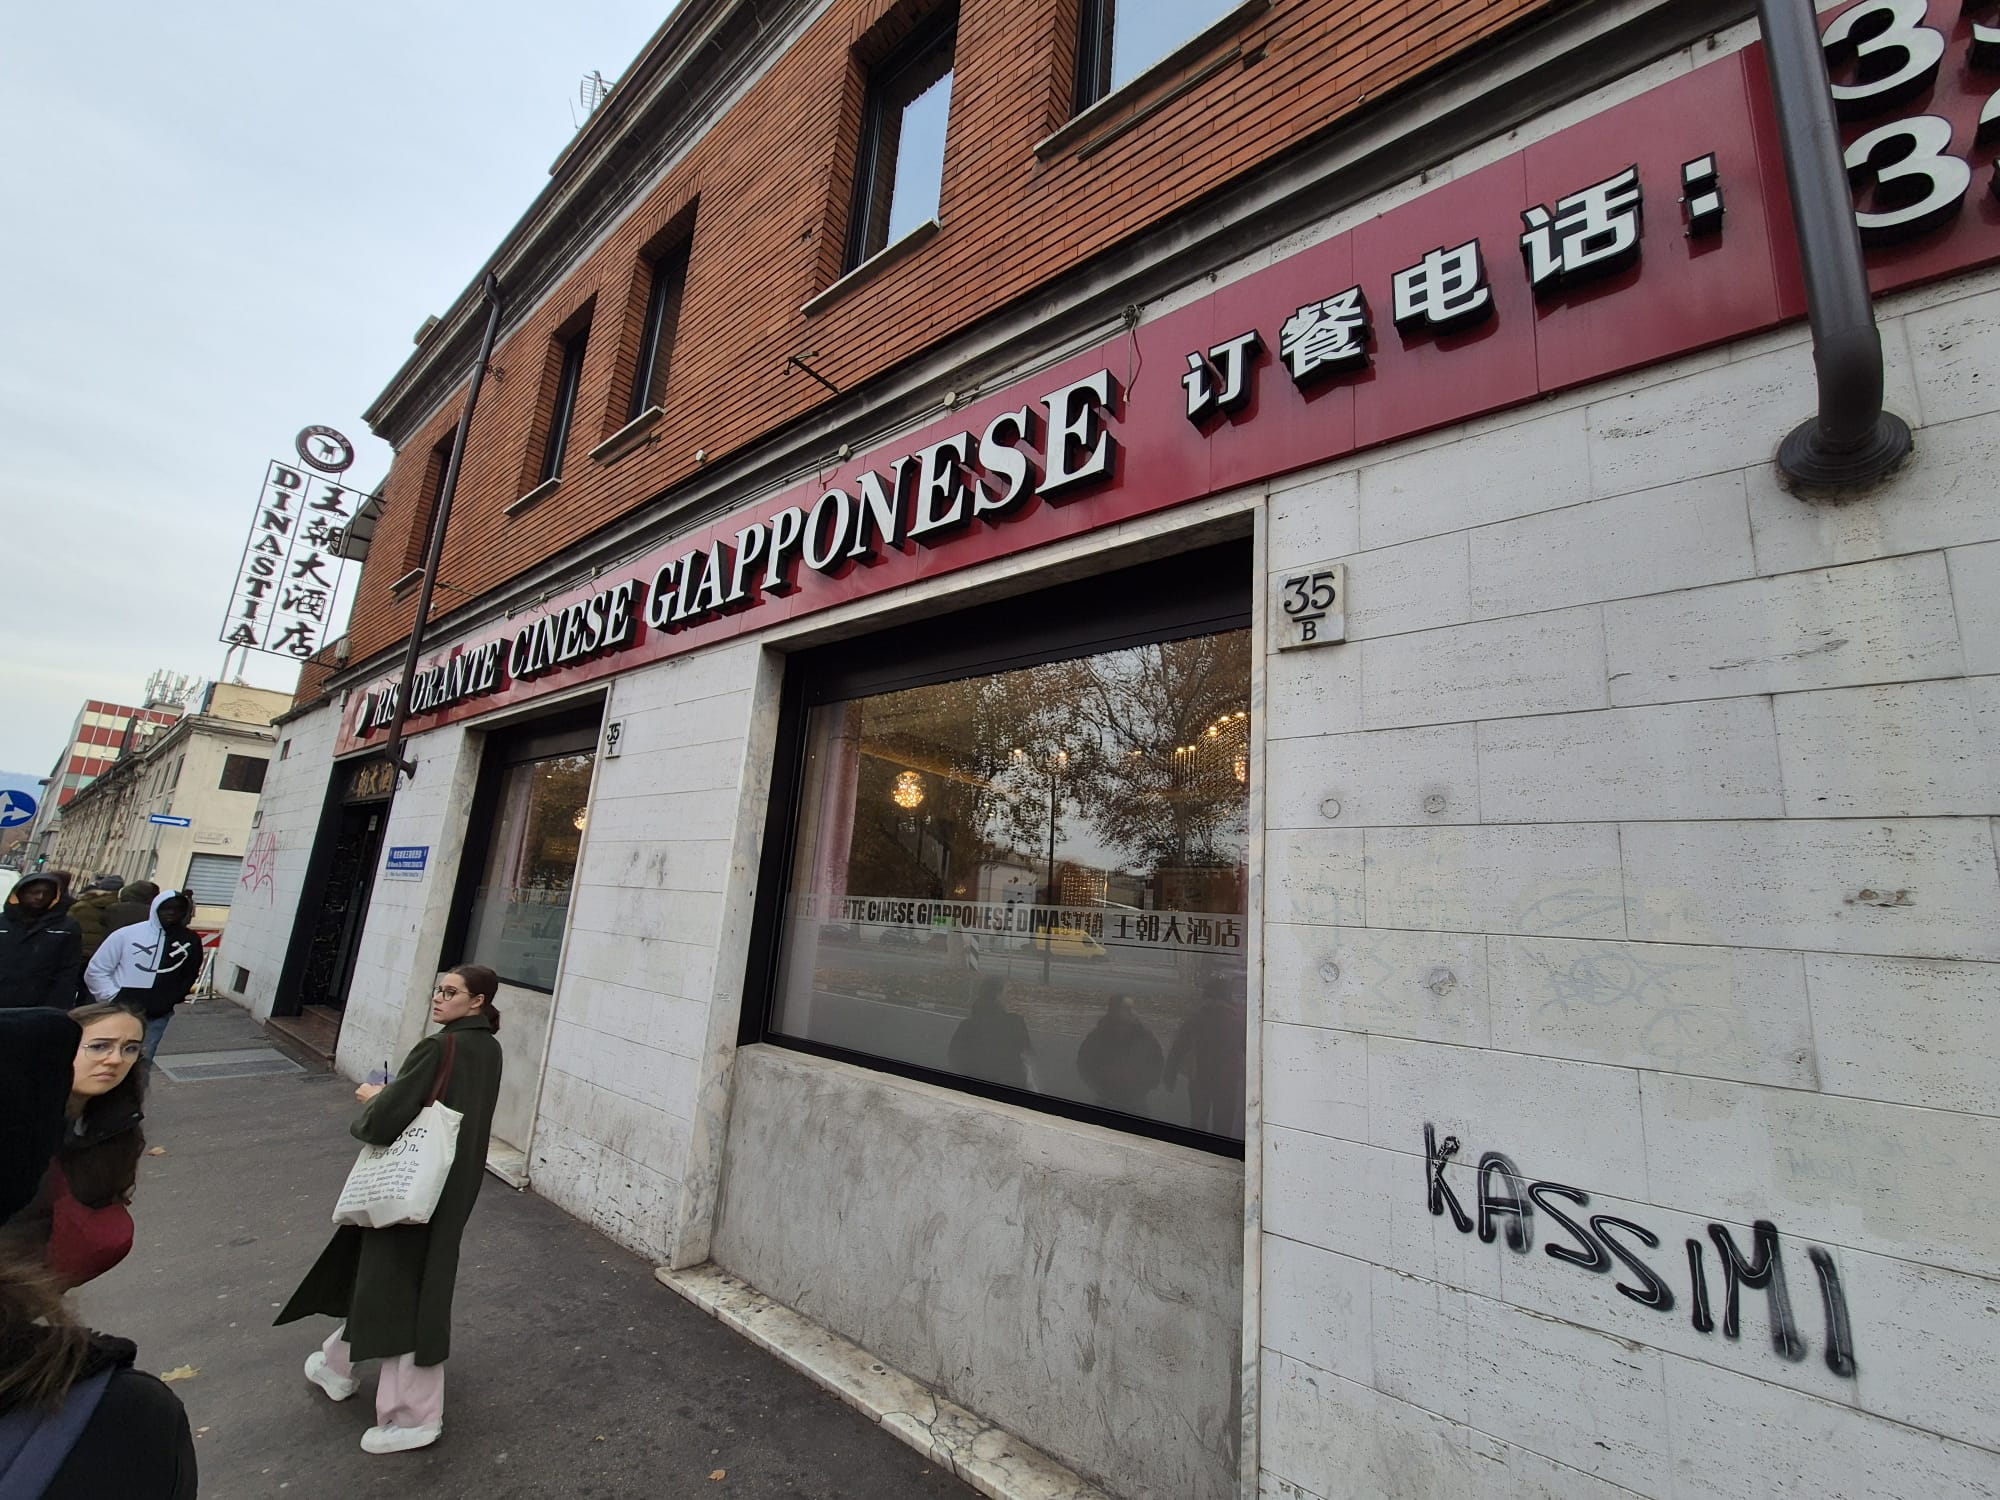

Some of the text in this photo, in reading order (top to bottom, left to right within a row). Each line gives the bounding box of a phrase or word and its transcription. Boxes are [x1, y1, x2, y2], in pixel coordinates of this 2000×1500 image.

[1823, 0, 2000, 99] 3
[1182, 151, 1722, 418] 订餐电话：
[227, 466, 303, 645] DINASTIA
[272, 486, 350, 657] 王朝大酒店
[508, 578, 634, 680] CINESE
[646, 368, 1111, 630] GIAPPONESE
[1283, 571, 1335, 614] 35
[1301, 620, 1317, 641] B
[607, 722, 621, 741] 35
[867, 900, 914, 924] CINESE
[917, 903, 1013, 931] GIAPPONESE
[1016, 908, 1104, 937] DINASTIA
[1111, 913, 1241, 948] 王朝大酒店
[1424, 1121, 1857, 1378] KASSIMI
